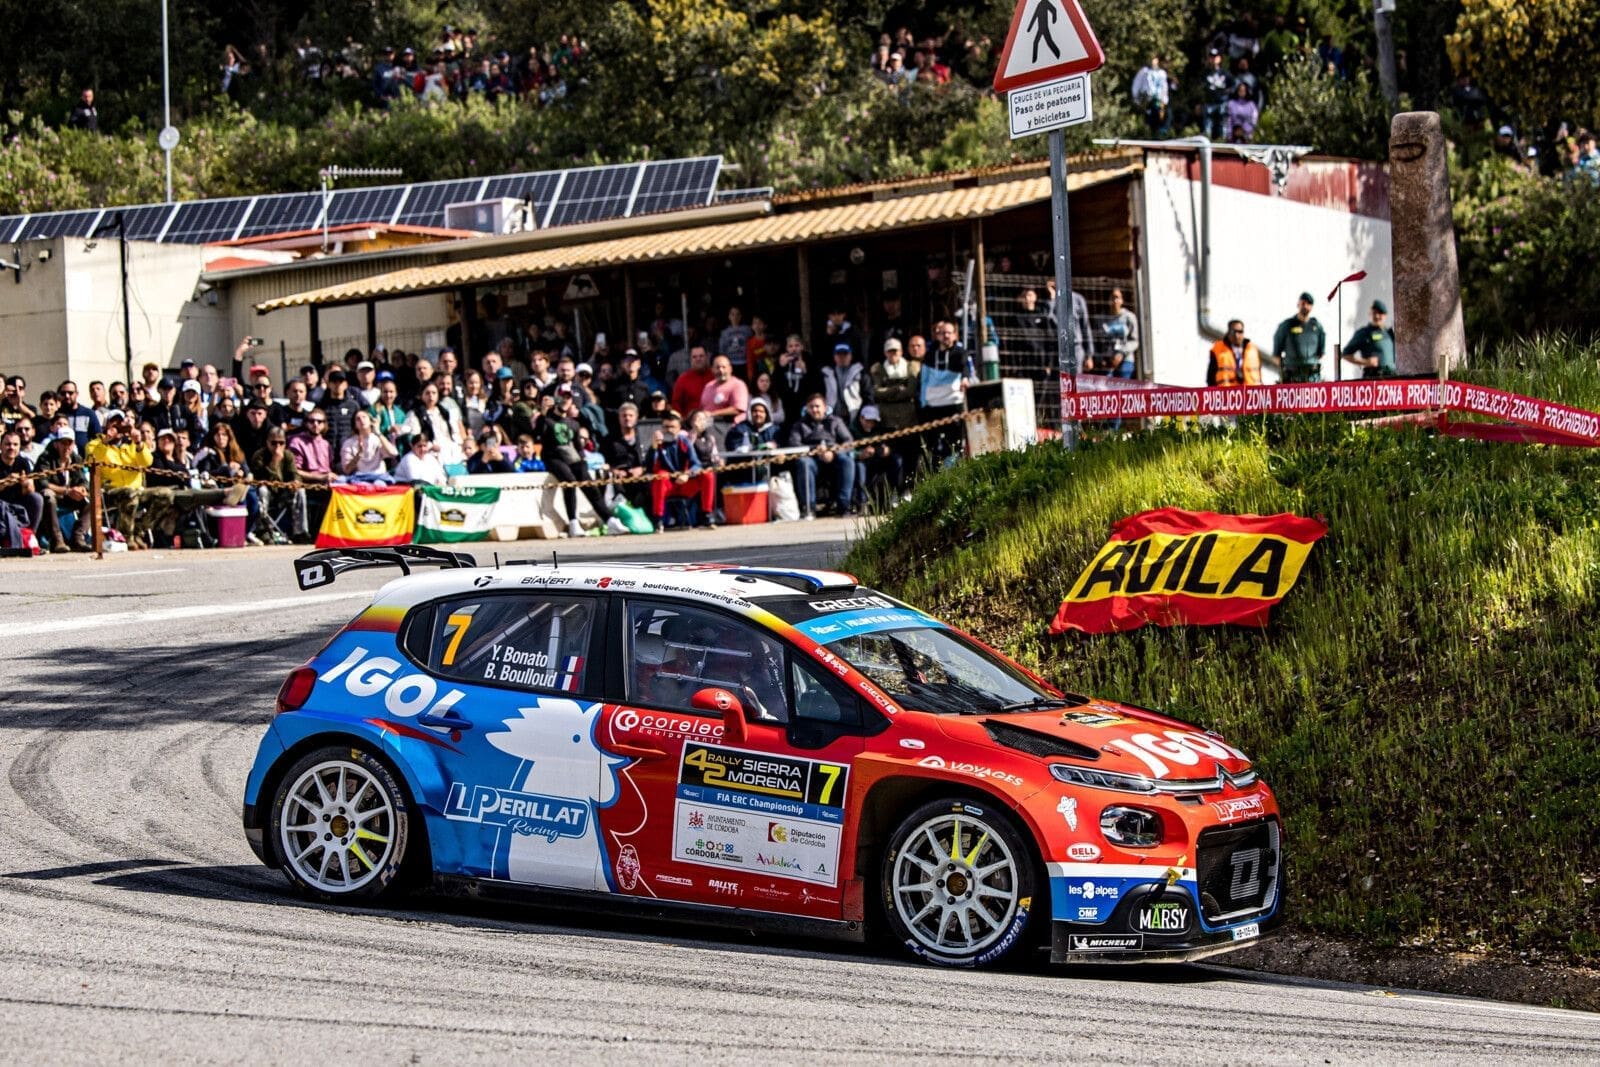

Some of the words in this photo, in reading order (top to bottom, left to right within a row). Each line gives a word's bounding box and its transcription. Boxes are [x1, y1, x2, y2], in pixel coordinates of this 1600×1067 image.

[1014, 93, 1033, 104] CRUCE
[1034, 91, 1042, 99] DE
[1053, 81, 1081, 95] PECUARIA
[1015, 104, 1034, 115] Paso
[1035, 101, 1045, 111] de
[1046, 93, 1081, 108] peatones
[1027, 119, 1032, 128] y
[1034, 110, 1071, 125] bicicletas
[1080, 394, 1118, 416] PUBLICO
[1122, 394, 1147, 414] ZONA
[1150, 391, 1200, 413] PROHIBIDO
[1203, 390, 1242, 411] PUBLICO
[1247, 389, 1272, 410] ZONA
[1276, 386, 1327, 409] PROHIBIDO
[1331, 386, 1373, 407] PUBLICO
[1376, 385, 1403, 406] ZONA
[1464, 389, 1509, 415] PUBLICO
[1511, 399, 1540, 423] ZONA
[1542, 406, 1599, 438] PROHIBIDO
[642, 582, 752, 609] boutique.citroenracing.com
[442, 613, 474, 666] 7
[492, 644, 502, 661] Y.
[503, 646, 548, 668] Bonato
[484, 662, 496, 680] B.
[499, 664, 558, 688] Boulloud
[642, 715, 724, 737] corelec
[707, 753, 742, 766] RALLY
[743, 759, 802, 778] SIERRA
[728, 771, 801, 792] MORENA
[819, 764, 842, 805] 7
[717, 793, 730, 802] FIA
[732, 795, 748, 805] ERC
[750, 798, 804, 814] Championship
[508, 817, 560, 843] Racing
[708, 815, 746, 827] AYUNTAMIENTO
[791, 829, 826, 841] Diputación
[1071, 847, 1096, 856] BELL
[708, 879, 739, 891] RALLYE
[1078, 909, 1098, 917] OMP
[1139, 908, 1189, 930] MARSY
[1089, 939, 1137, 947] MICHELIN
